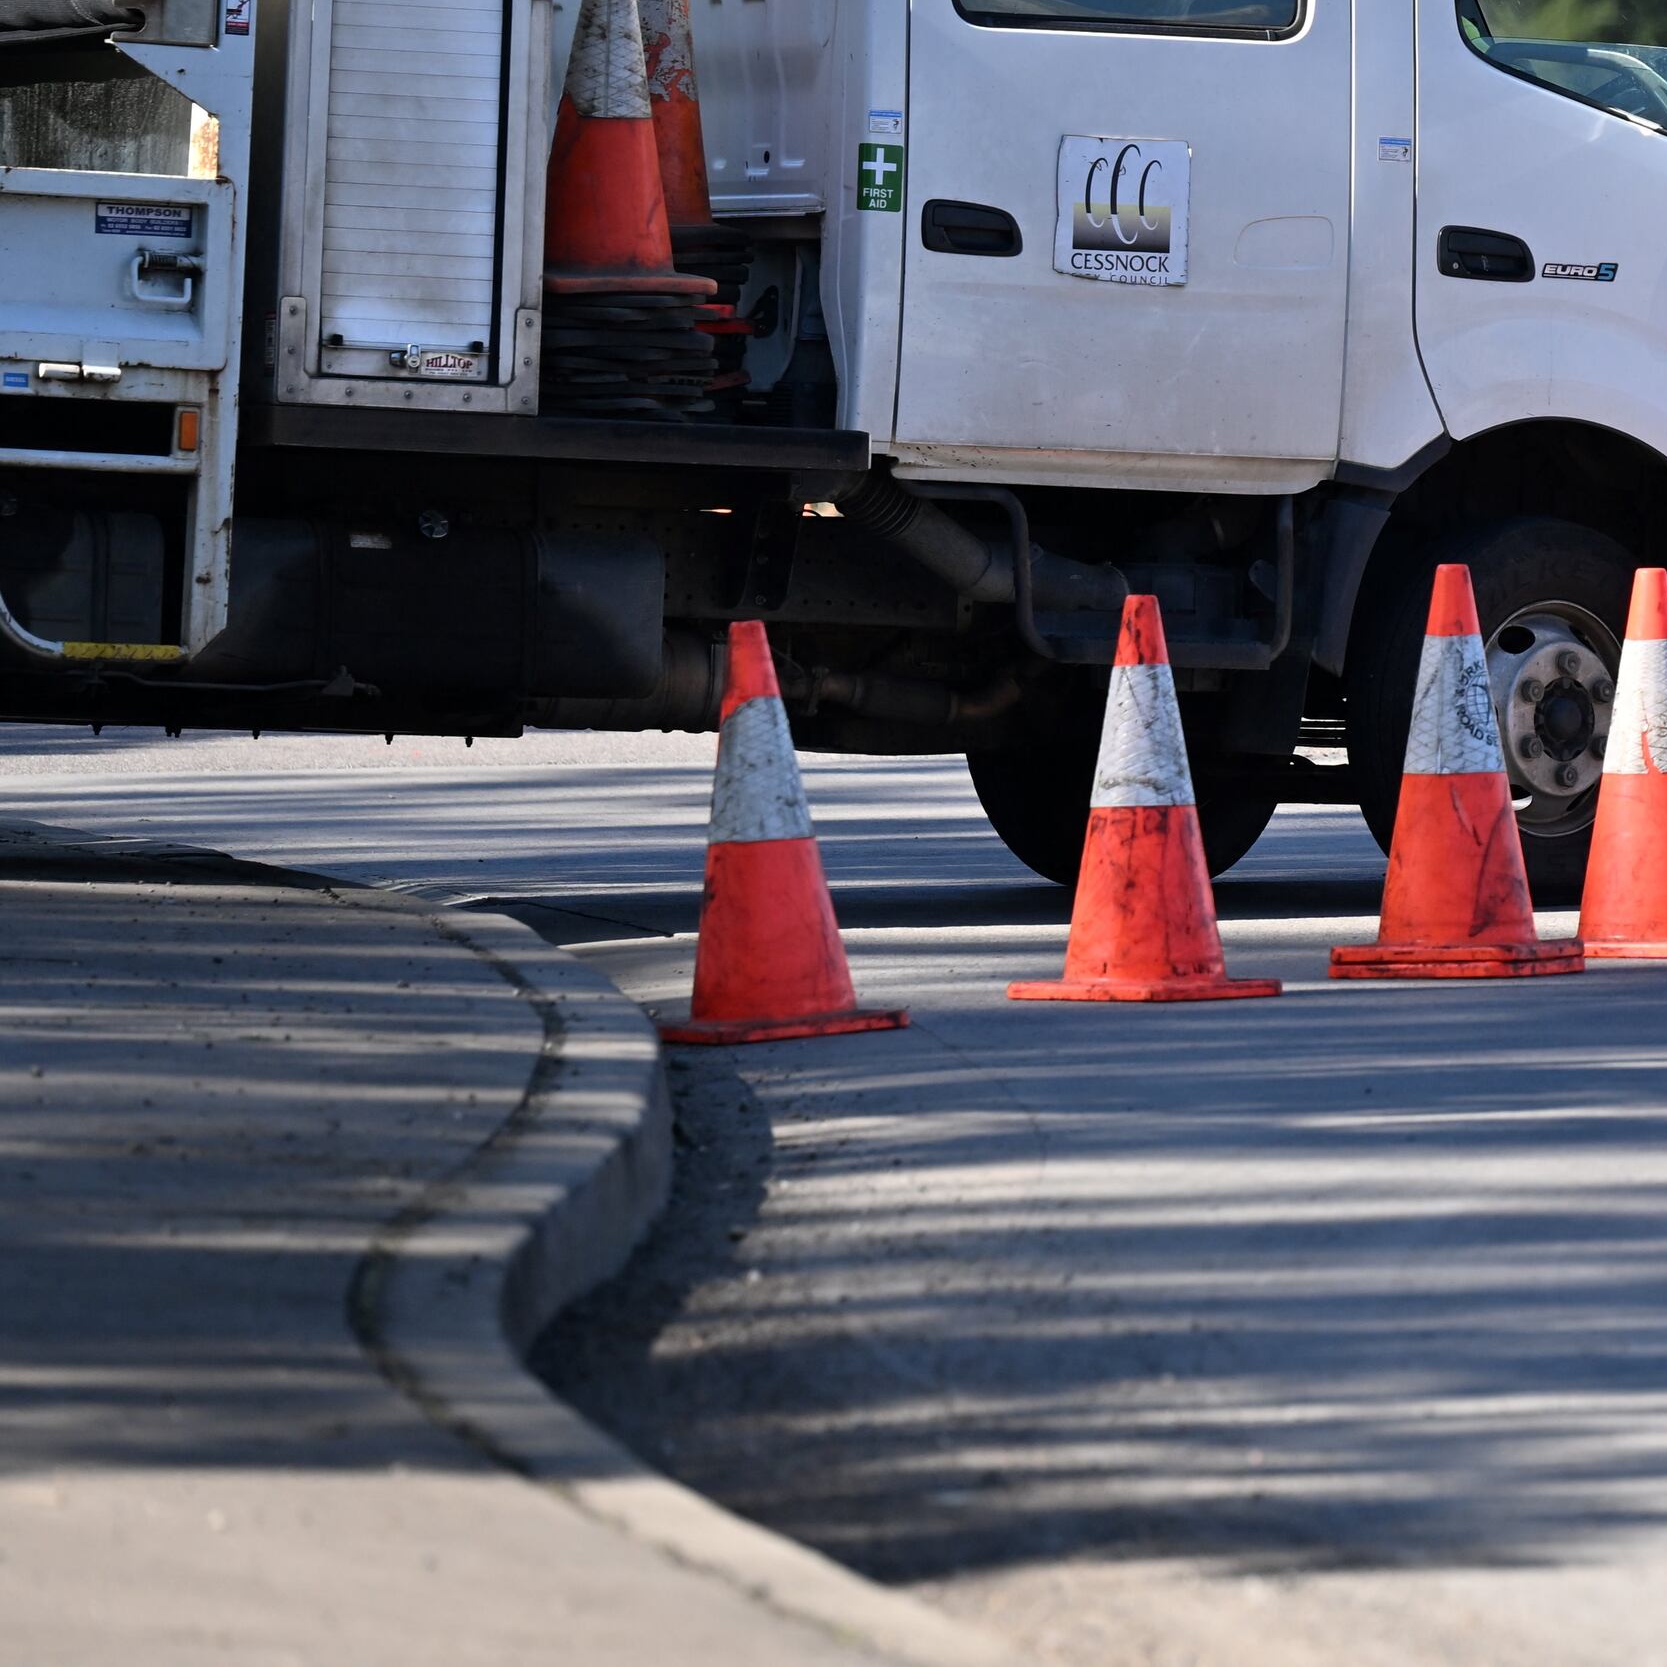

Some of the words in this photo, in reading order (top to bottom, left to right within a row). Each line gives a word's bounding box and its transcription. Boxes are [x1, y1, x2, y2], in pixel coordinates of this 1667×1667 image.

[863, 187, 894, 199] FIRST
[868, 198, 888, 209] AID
[106, 206, 182, 218] THOMPSON
[1071, 252, 1169, 273] CESSNOCK
[426, 354, 473, 369] HILLTOP
